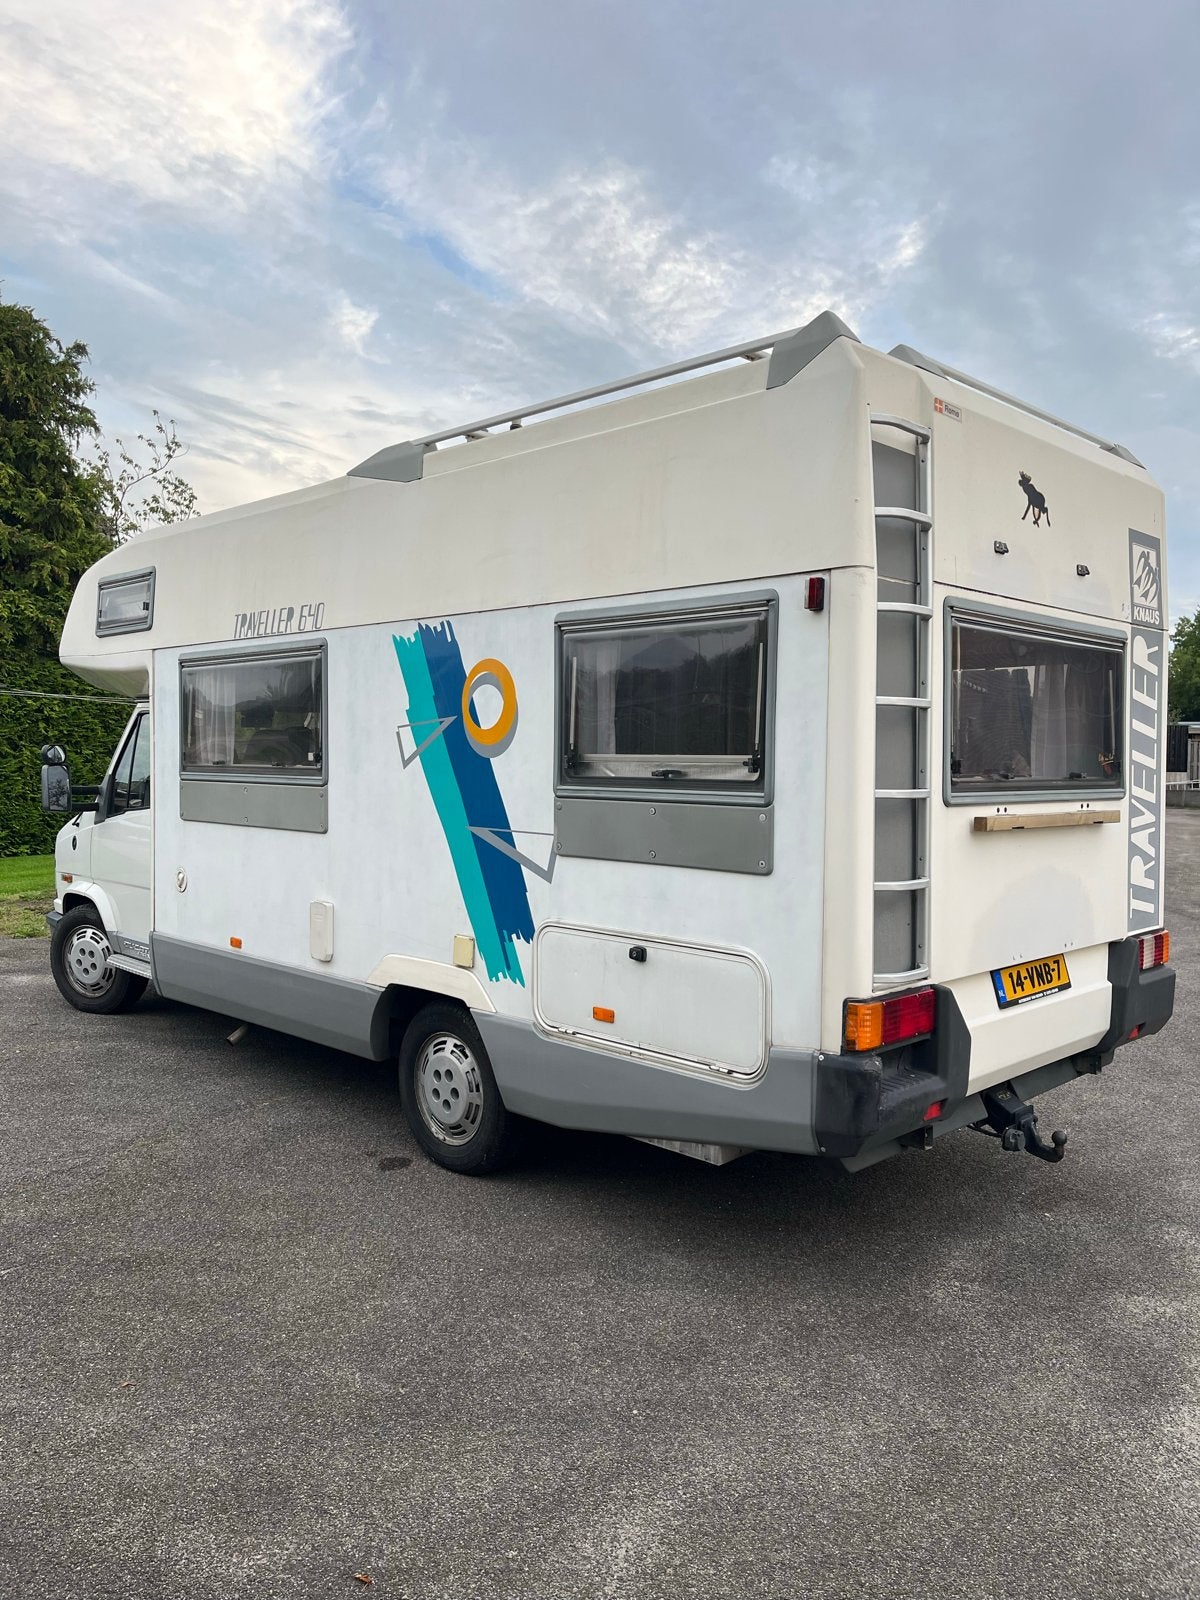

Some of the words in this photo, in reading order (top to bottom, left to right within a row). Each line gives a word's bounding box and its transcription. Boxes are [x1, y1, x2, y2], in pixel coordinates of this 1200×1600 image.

[233, 606, 295, 639] TRAVELLER
[298, 602, 325, 631] 640
[1133, 606, 1160, 625] KNAUS
[1129, 634, 1159, 919] TRAVELLER
[1008, 959, 1061, 995] 14-VNB-7
